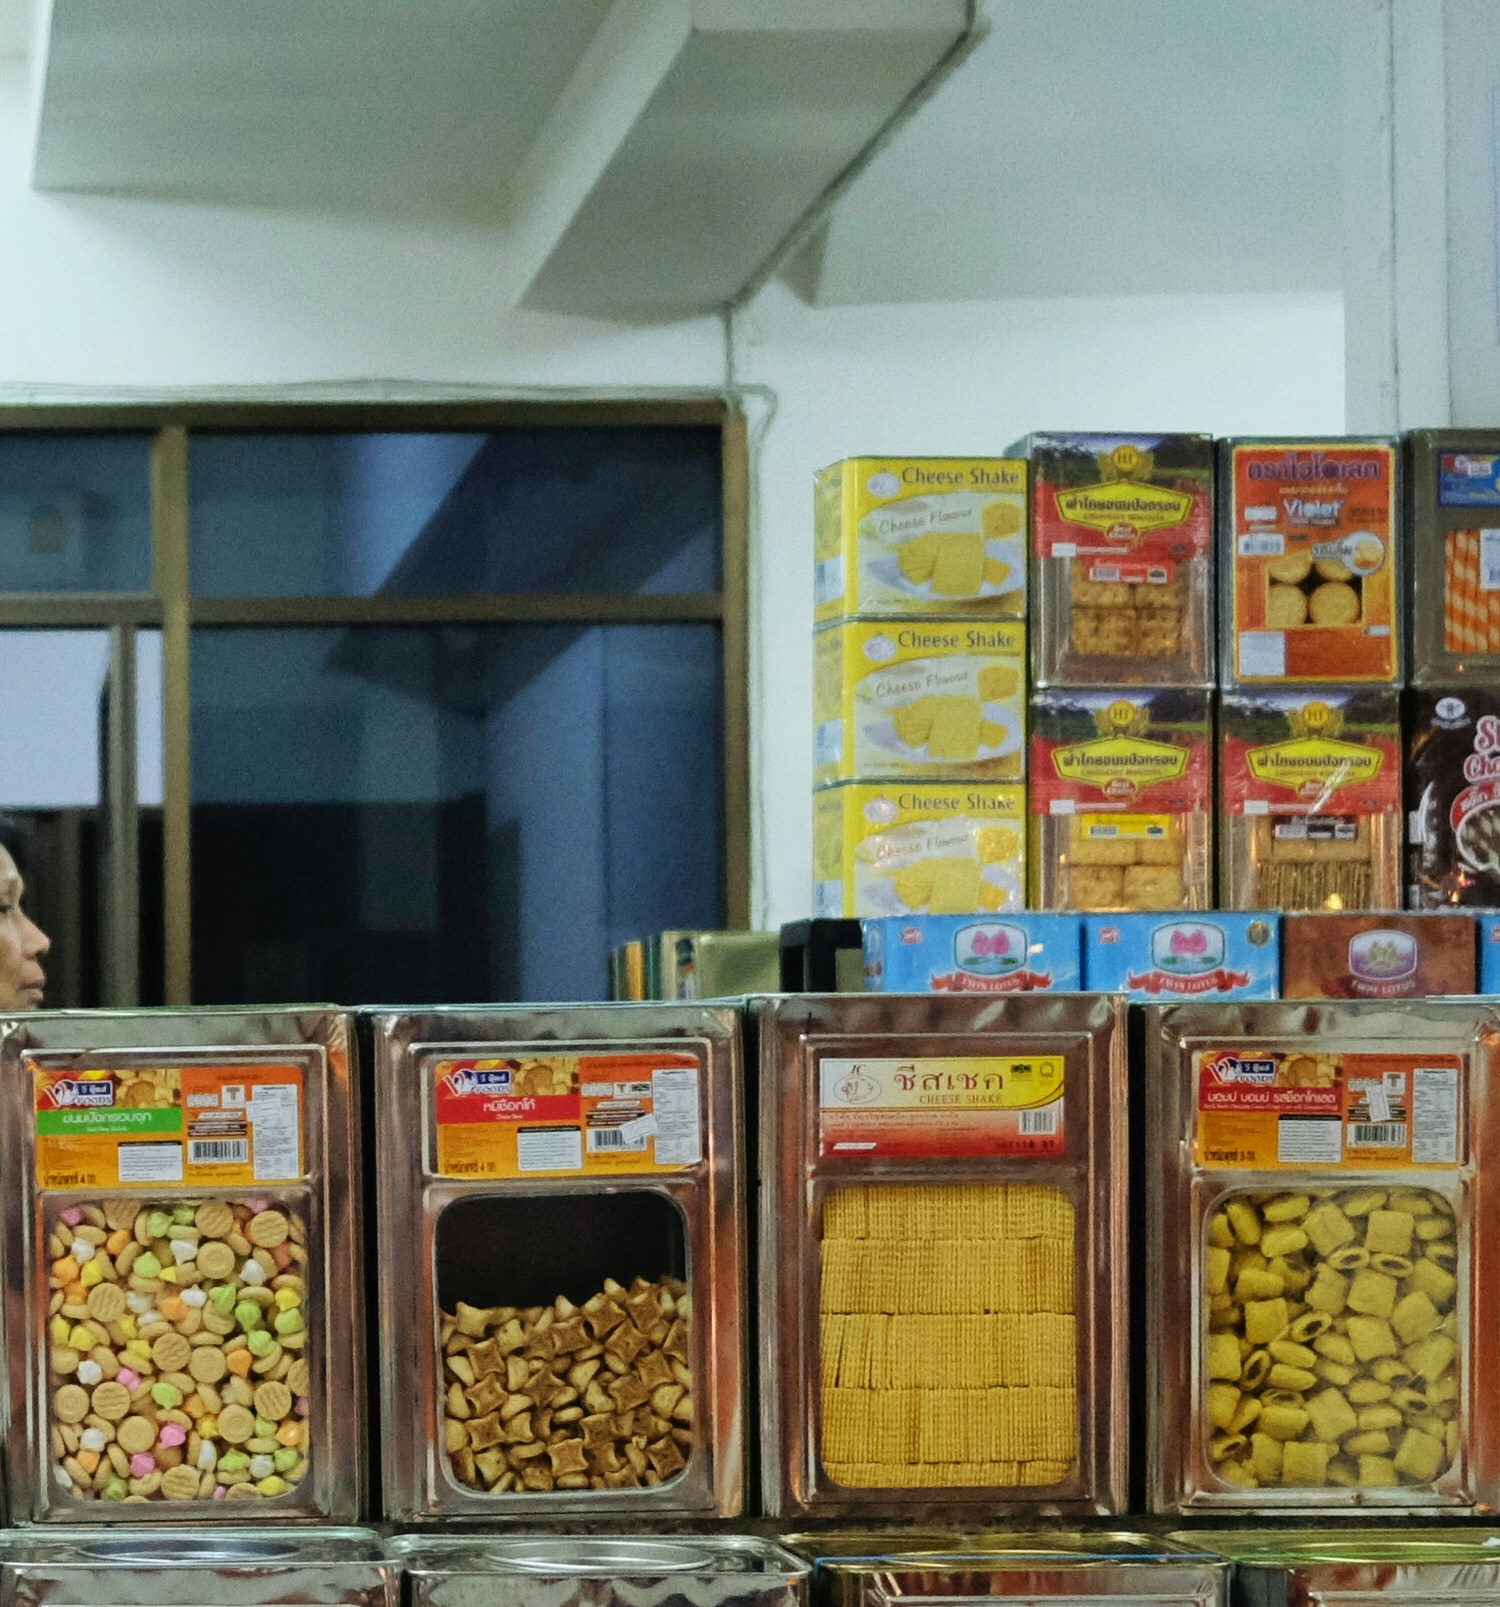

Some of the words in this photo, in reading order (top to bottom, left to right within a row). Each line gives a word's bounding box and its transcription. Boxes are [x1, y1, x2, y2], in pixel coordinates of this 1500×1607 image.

[901, 467, 963, 486] Cheese
[970, 467, 1019, 485] Shake
[898, 630, 961, 649] Cheese
[965, 630, 1016, 648] Shake
[898, 793, 961, 812] Cheese
[966, 793, 1016, 811] Shake
[919, 1094, 961, 1105] CHEESE
[965, 1093, 1003, 1105] SHAKE
